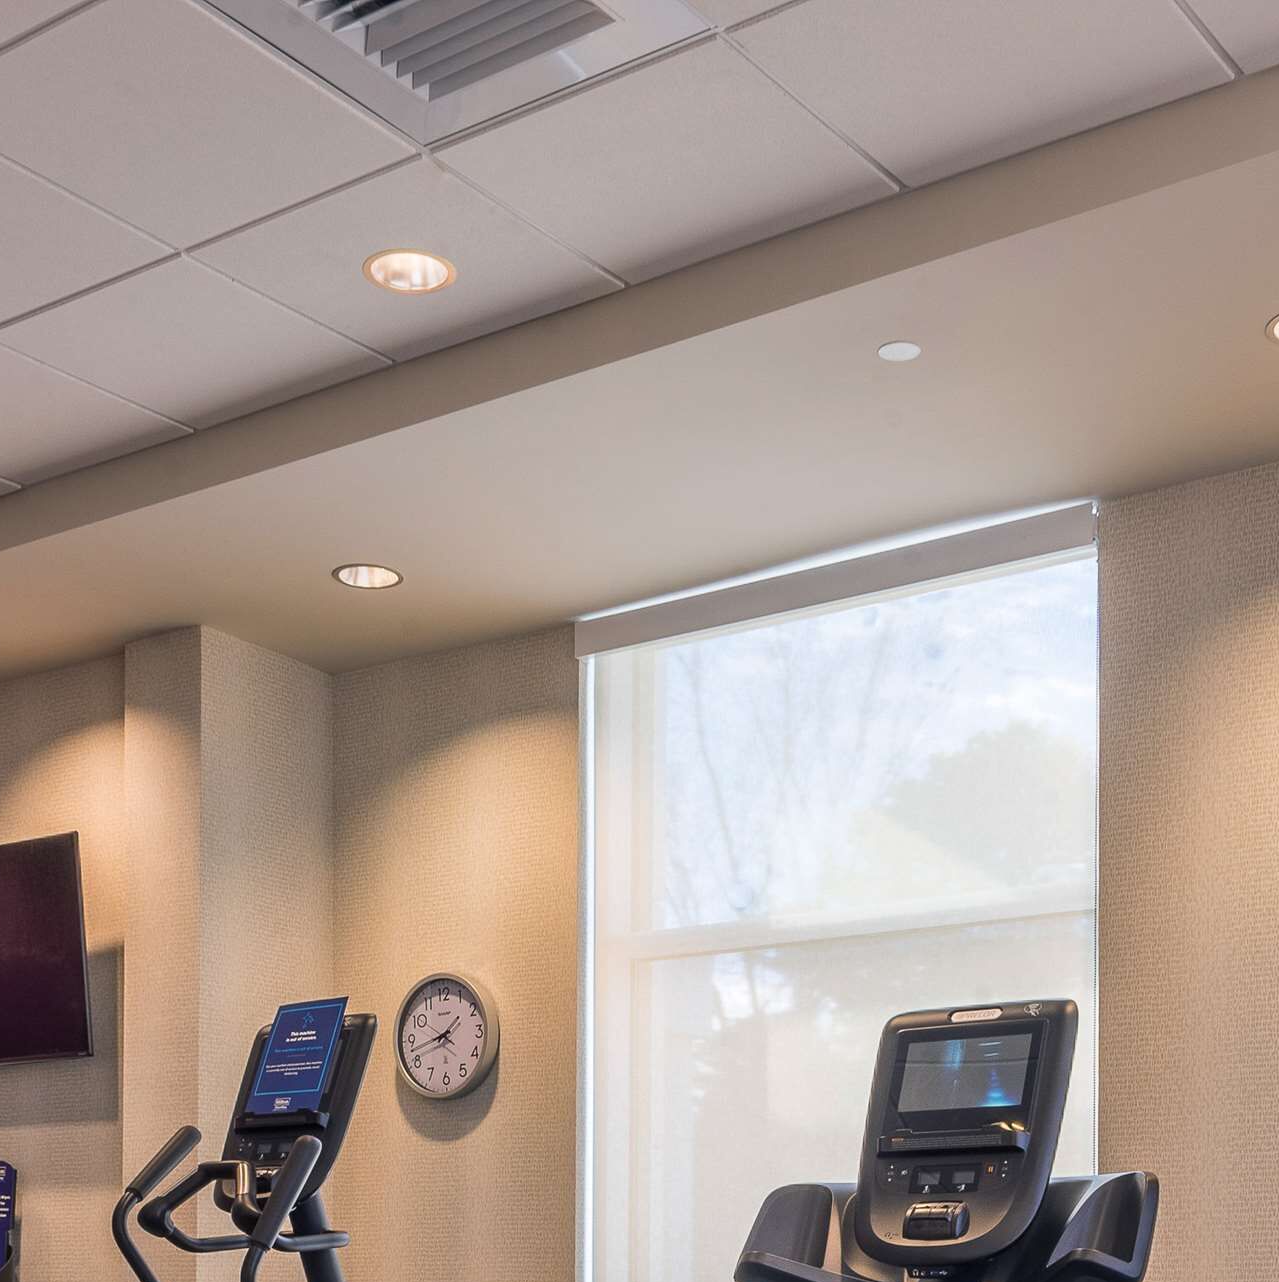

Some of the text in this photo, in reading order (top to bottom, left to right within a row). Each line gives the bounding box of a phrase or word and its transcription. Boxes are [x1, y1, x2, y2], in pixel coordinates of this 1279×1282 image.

[438, 986, 450, 1002] 12
[458, 989, 462, 1004] 1
[424, 996, 433, 1011] 11
[469, 1002, 477, 1017] 2
[412, 1013, 428, 1029] 10
[475, 1024, 484, 1039] 3
[407, 1033, 416, 1048] 9
[470, 1045, 479, 1060] 4
[413, 1054, 422, 1069] 8
[426, 1066, 435, 1082] 7
[459, 1063, 468, 1078] 5
[442, 1071, 451, 1086] 6
